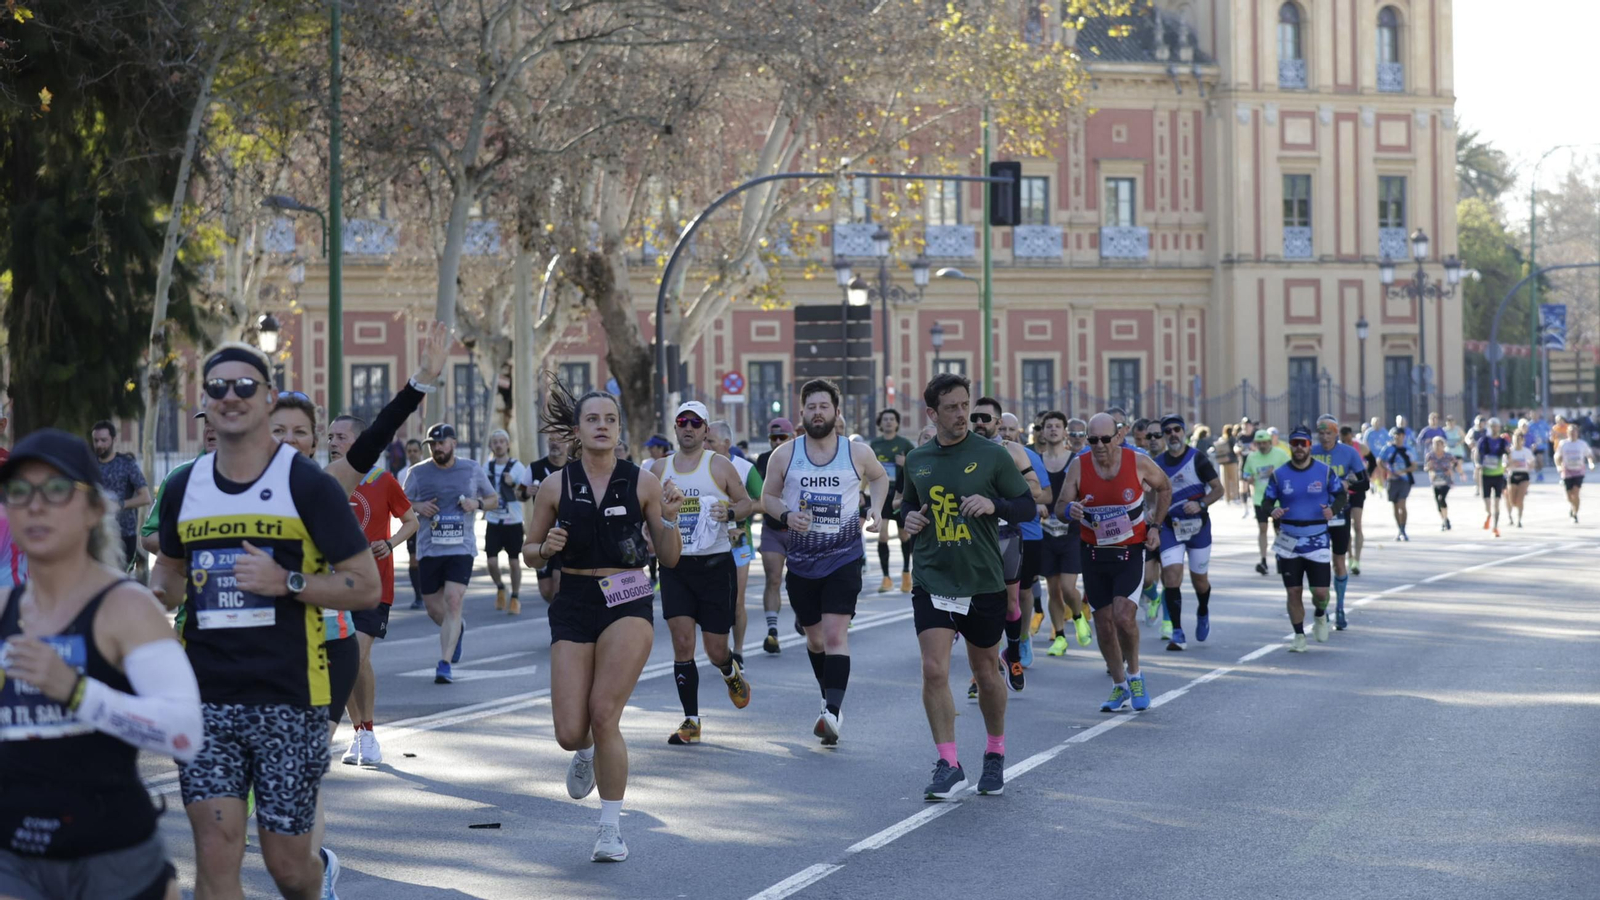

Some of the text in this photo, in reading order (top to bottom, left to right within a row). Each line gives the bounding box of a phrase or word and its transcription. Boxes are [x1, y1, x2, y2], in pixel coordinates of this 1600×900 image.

[800, 476, 840, 488] CHRIS
[681, 488, 700, 497] VID
[1103, 510, 1123, 519] ZURICH
[186, 520, 283, 538] ful-on tri
[1106, 527, 1121, 536] ROB
[218, 553, 240, 565] ZU
[605, 583, 653, 604] WILDGOOSE
[218, 591, 245, 609] RIC
